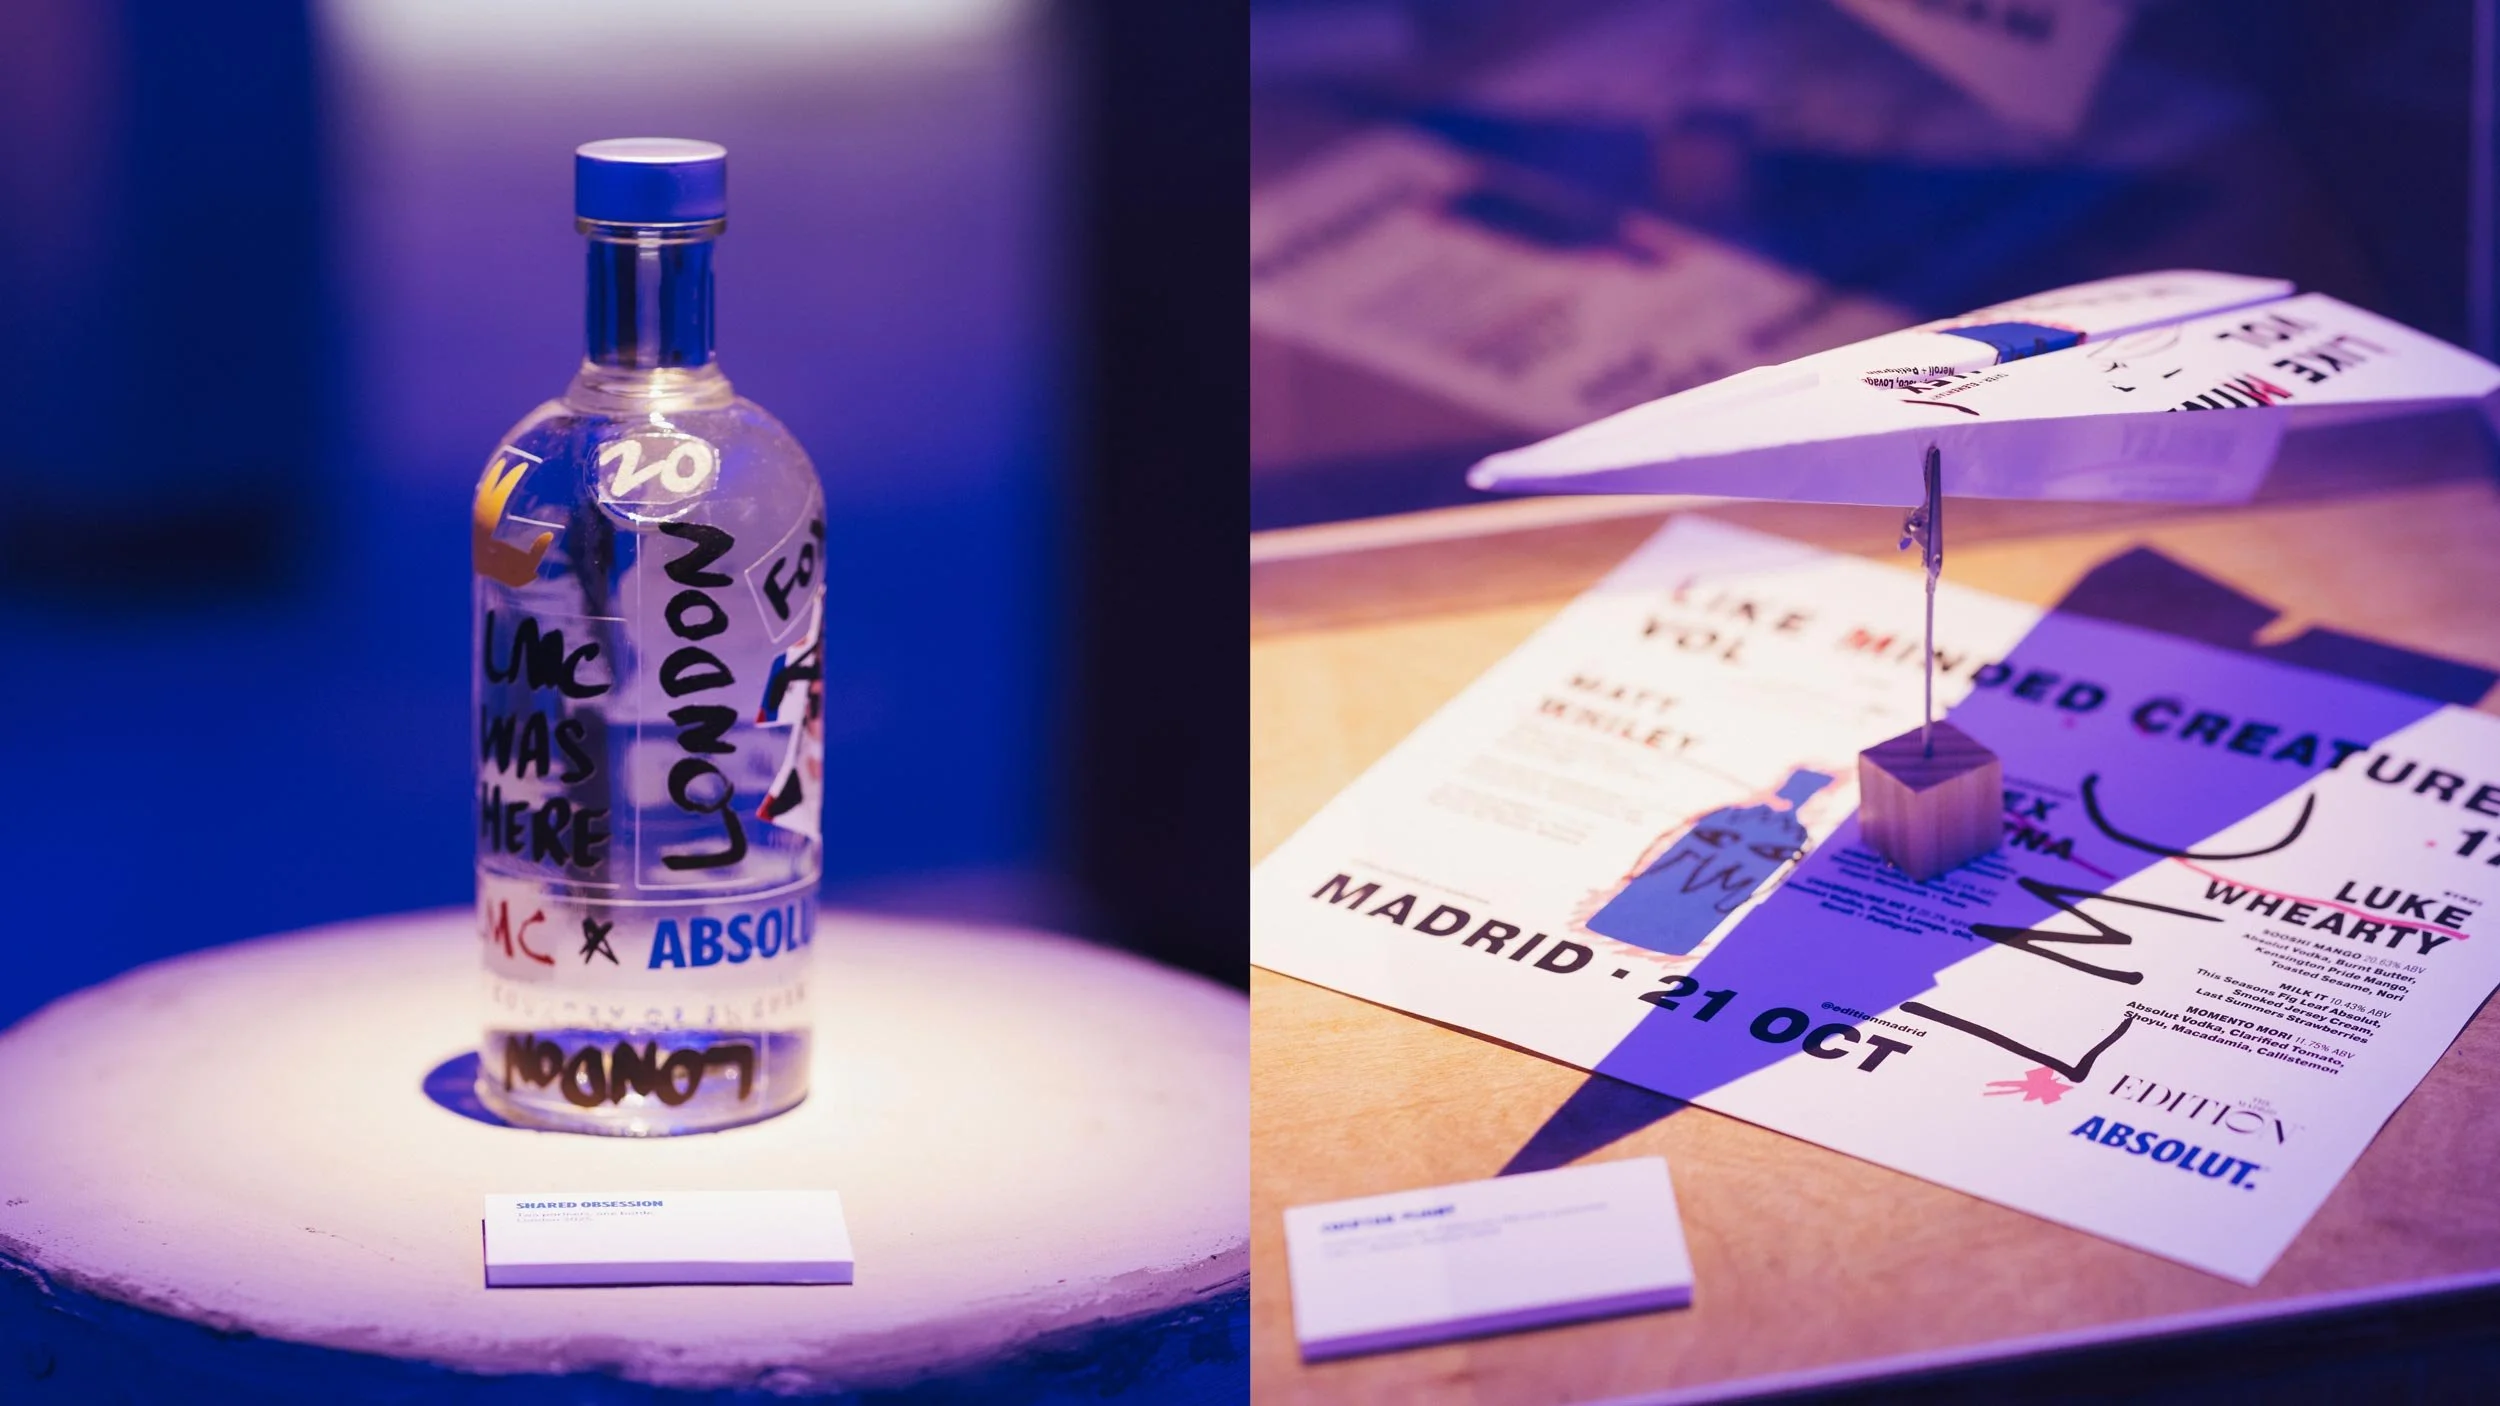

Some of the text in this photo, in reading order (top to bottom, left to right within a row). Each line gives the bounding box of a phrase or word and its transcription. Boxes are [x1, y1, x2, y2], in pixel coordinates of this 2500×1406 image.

[1929, 366, 1955, 377] Neroli
[600, 439, 711, 498] 20
[485, 609, 612, 699] LMC
[658, 521, 748, 871] LONDON
[480, 704, 595, 784] WAS
[2131, 697, 2500, 818] CREATURE
[480, 784, 612, 869] HERE
[2204, 879, 2452, 956] WHEARTY
[2335, 881, 2473, 930] LUKE
[1311, 872, 1595, 975] MADRID
[1637, 974, 1740, 1023] 21
[1748, 1005, 1914, 1073] OCT
[2242, 932, 2417, 986] Absolut Vodka, Burnt Butter,
[2254, 946, 2411, 996] Kensington Pride Mango,
[2270, 960, 2406, 1003] Toasted Sesame, Nori
[2313, 942, 2363, 961] MANGO
[2402, 963, 2428, 976] ABV
[1821, 1001, 1928, 1039] @editionmadrid
[2195, 987, 2370, 1045] Last Summers Strawberries
[2196, 967, 2382, 1029] This Seasons Fig Leaf Absolut,
[2232, 988, 2375, 1037] Smoked Jersey Cream,
[2278, 982, 2393, 1020] MILK IT 10.43% ABV
[2122, 1010, 2340, 1076] Shoyu, Macadamia, Callistemon
[2125, 1000, 2345, 1069] Absolut Vodka, Clarified Tomato,
[2185, 1005, 2357, 1061] MOMENTO MORI 11.75% ABV
[503, 1033, 756, 1108] LONDON
[2109, 1073, 2300, 1146] EDITION
[516, 1200, 664, 1210] SHARED OBSESSION
